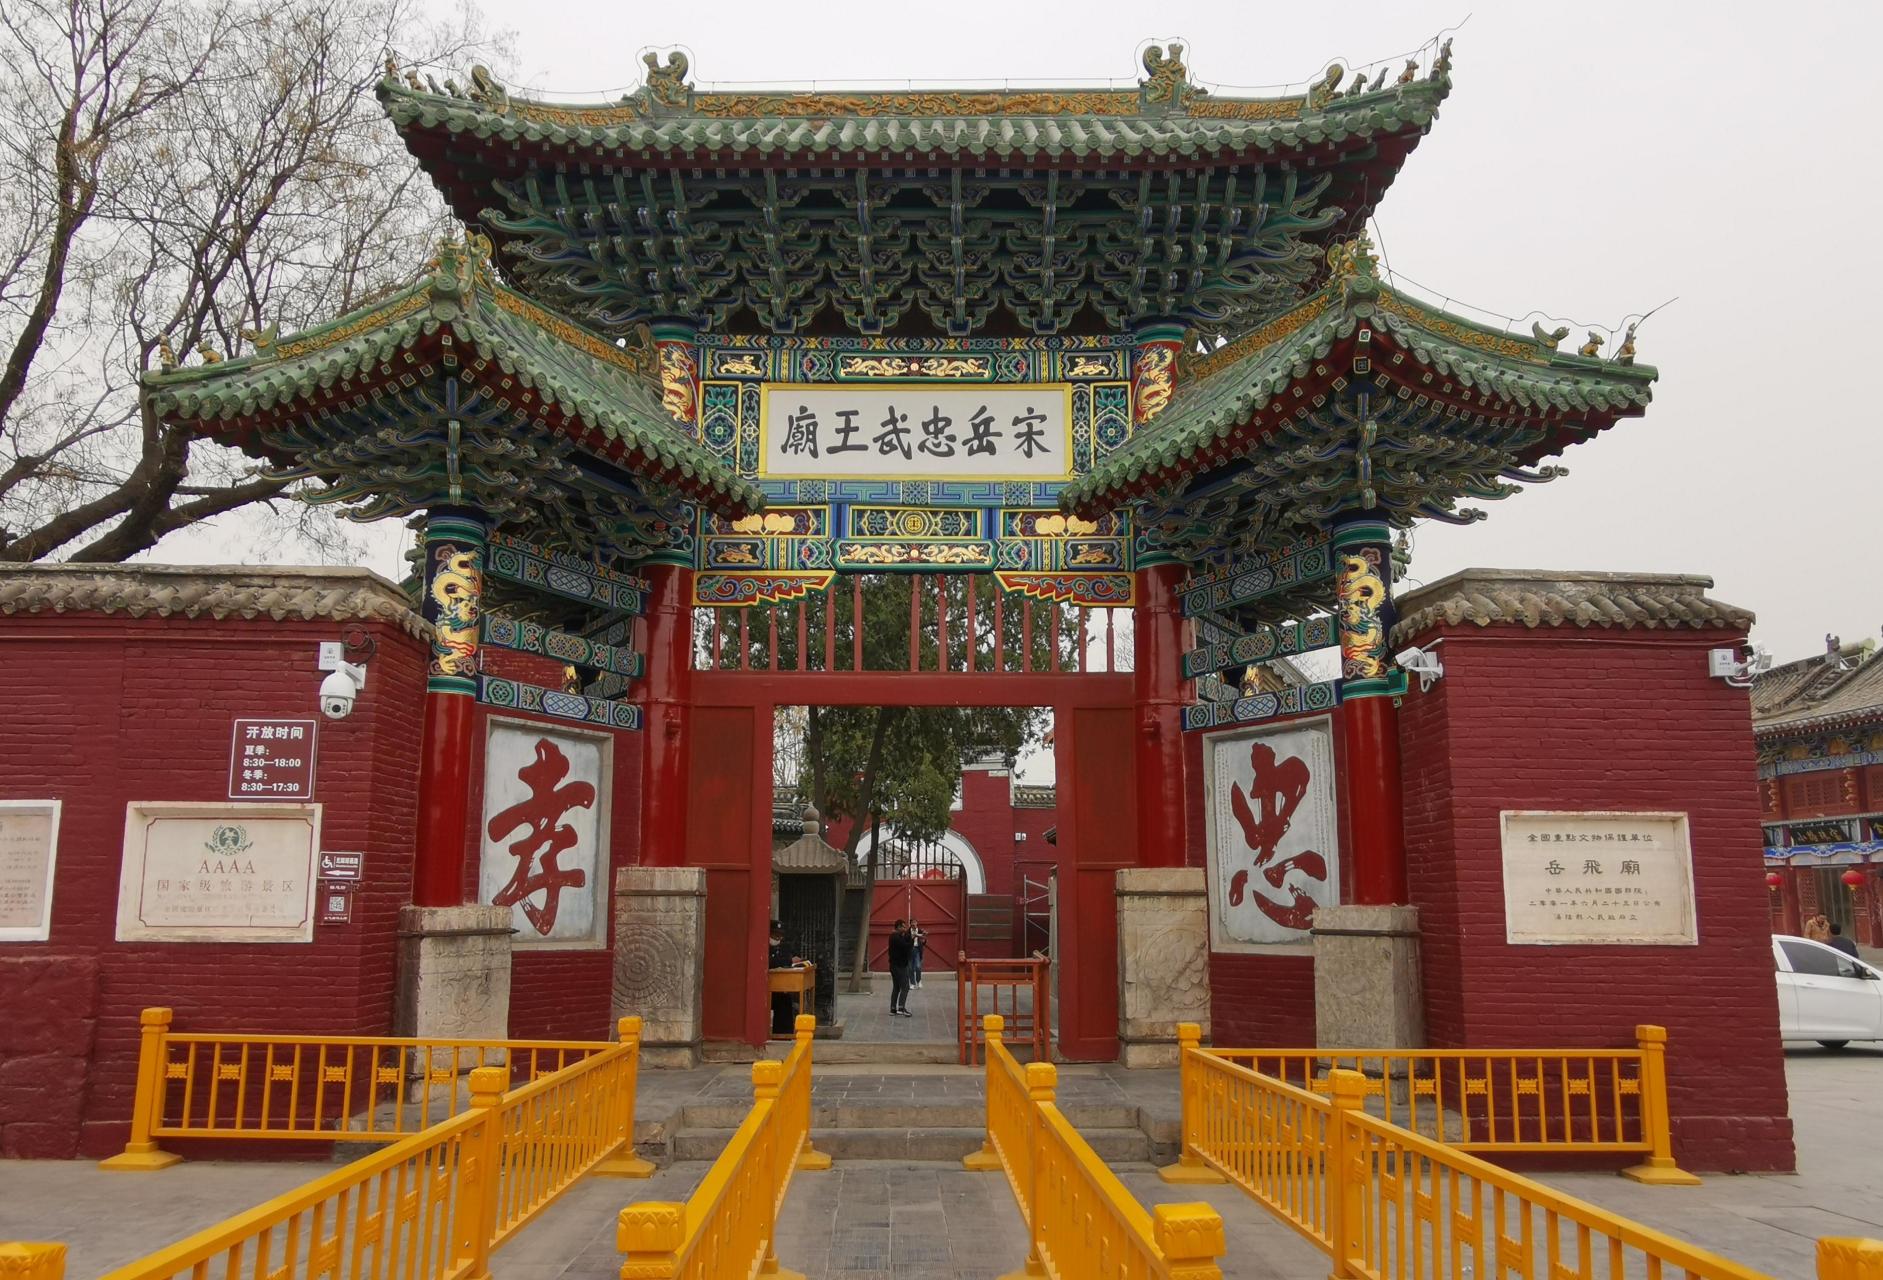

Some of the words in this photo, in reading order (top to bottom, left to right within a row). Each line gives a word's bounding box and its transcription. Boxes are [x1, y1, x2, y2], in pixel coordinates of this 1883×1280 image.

[246, 726, 304, 739] 开放时间
[1527, 832, 1654, 843] 全國重點文物保護單位
[198, 859, 256, 874] AAAA
[1544, 859, 1641, 876] 岳飛廟
